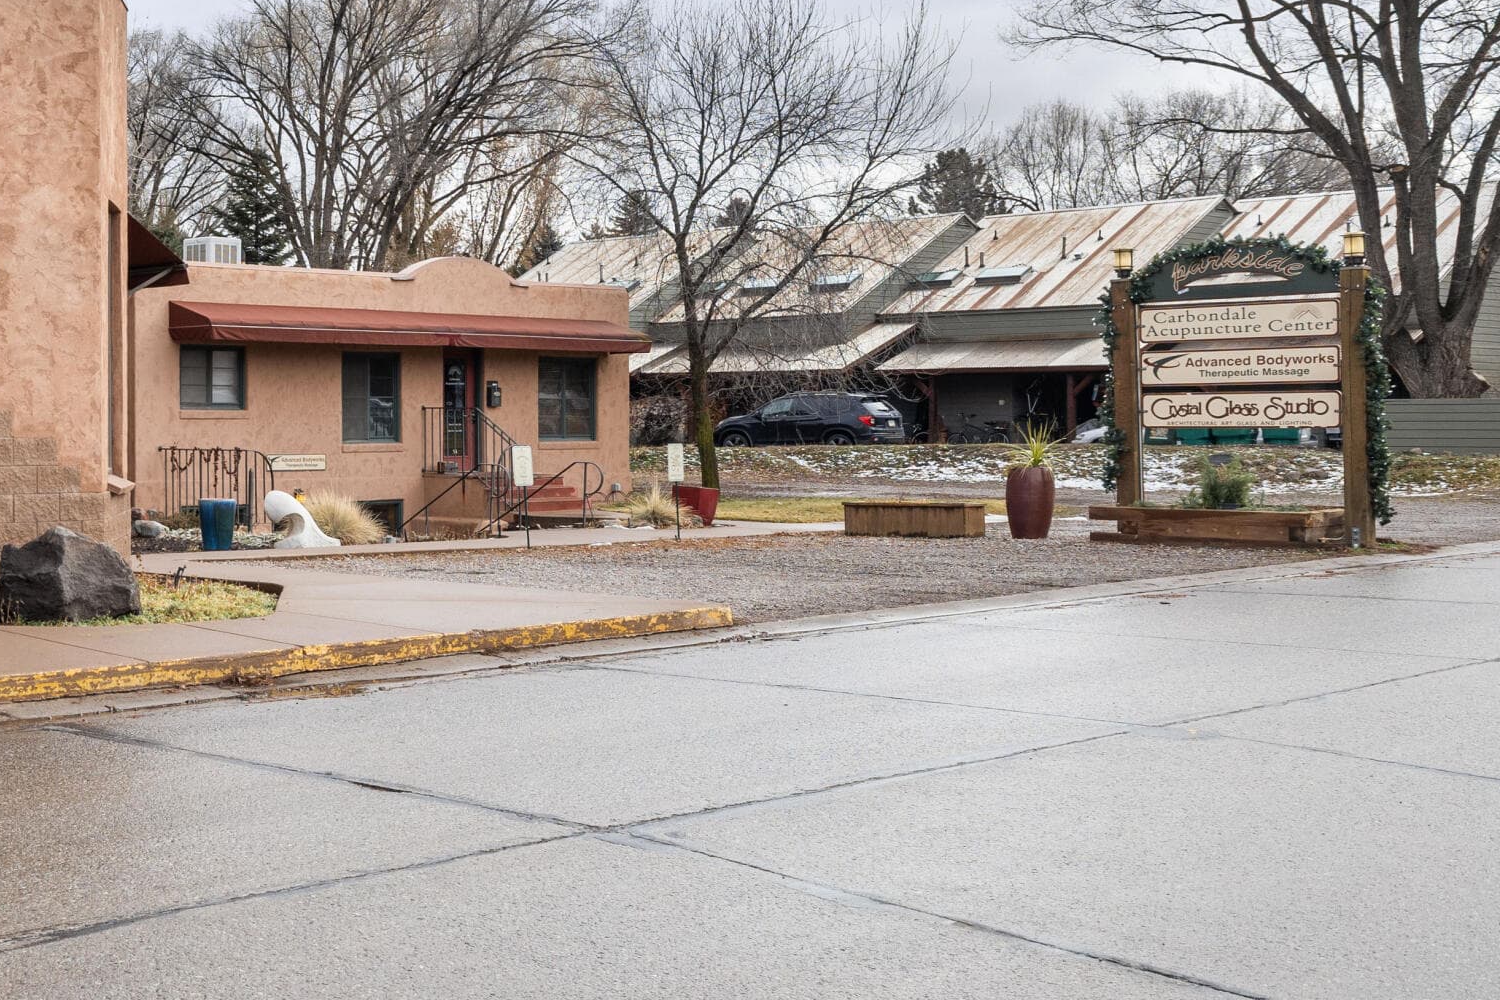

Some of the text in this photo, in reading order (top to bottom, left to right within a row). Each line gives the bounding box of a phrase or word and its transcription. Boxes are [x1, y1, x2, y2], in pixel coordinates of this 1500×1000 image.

[1172, 249, 1305, 292] parkside
[1153, 306, 1257, 325] Carbondale
[1146, 319, 1334, 340] Acupuncture Center
[1185, 353, 1335, 368] Advanced Bodyworks
[1199, 367, 1310, 379] Therapeutic Massage
[1151, 396, 1329, 421] Crystal Glass Studio
